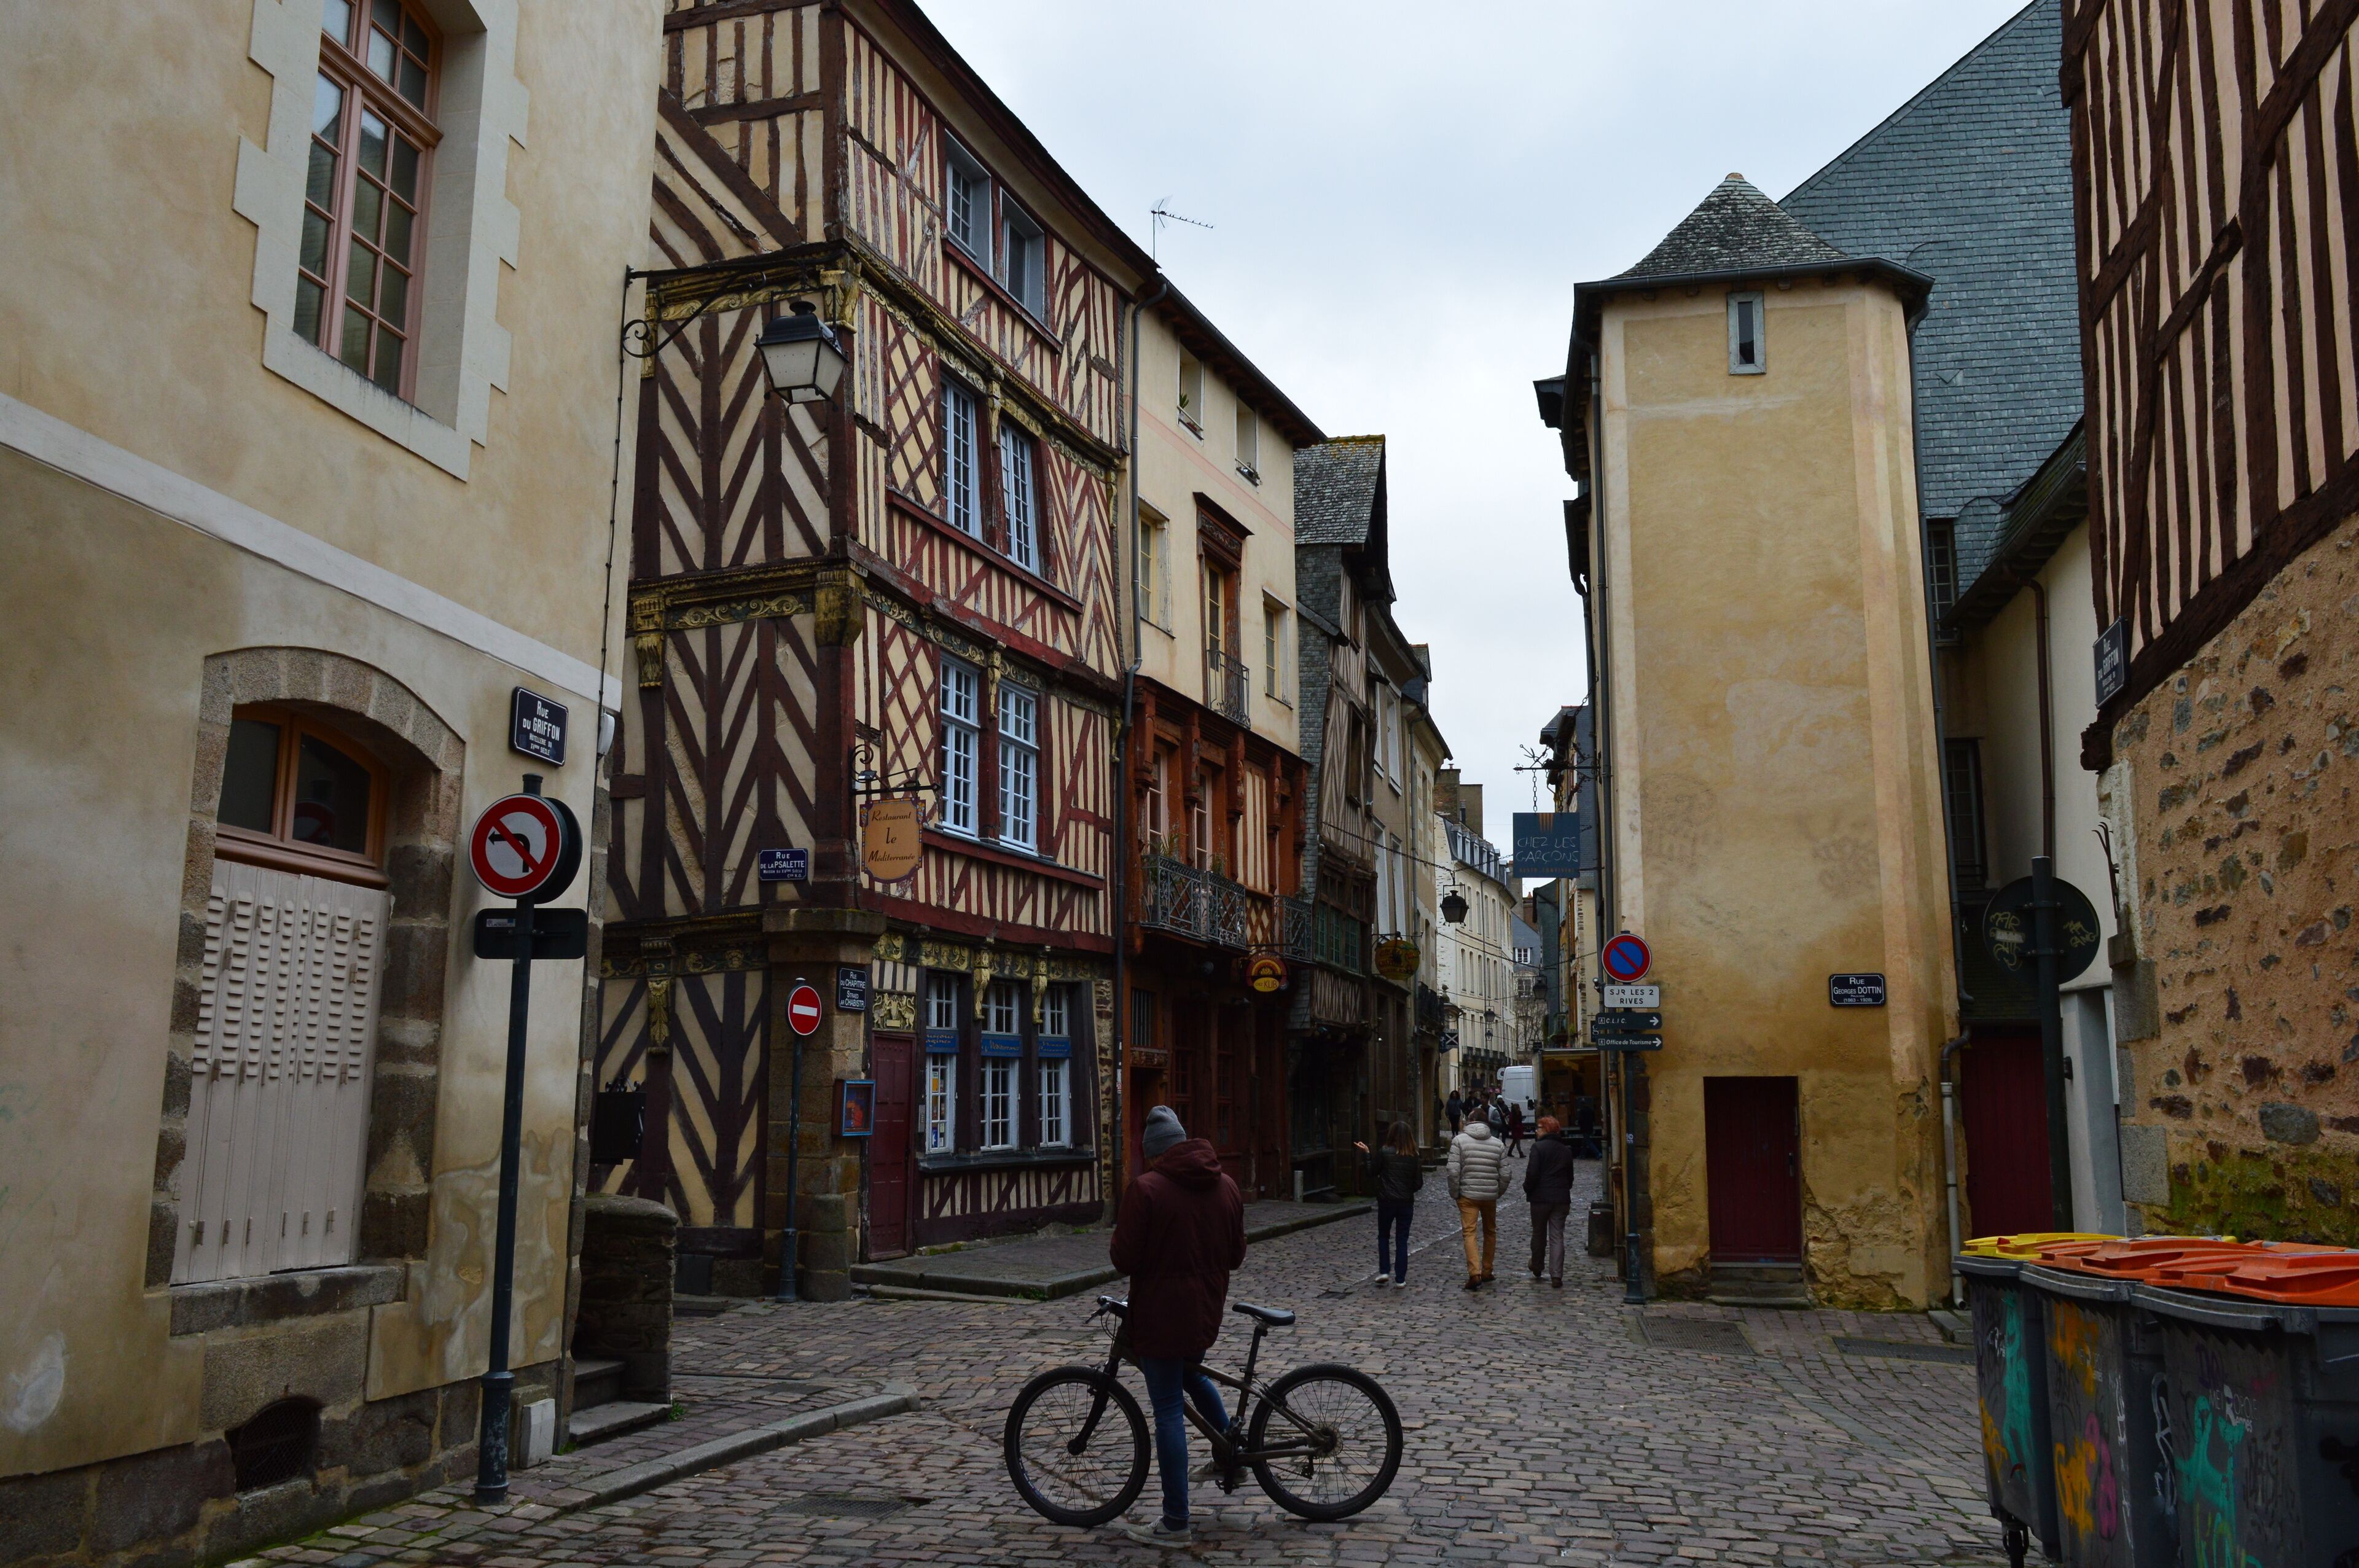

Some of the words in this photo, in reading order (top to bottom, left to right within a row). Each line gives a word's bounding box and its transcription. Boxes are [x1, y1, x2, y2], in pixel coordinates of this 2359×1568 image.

[536, 700, 549, 719] RUE
[523, 717, 531, 730] DU
[533, 717, 560, 741] GRIFFON
[872, 810, 912, 821] Restaurant
[1517, 836, 1548, 848] CHEZ
[1554, 837, 1576, 848] LES
[868, 850, 915, 862] Méditerranée
[1516, 851, 1579, 865] GARÇONS
[845, 978, 866, 989] CHAPITRE
[1264, 980, 1277, 989] KUB
[847, 990, 859, 999] STRAED
[845, 998, 864, 1008] CHABISTR
